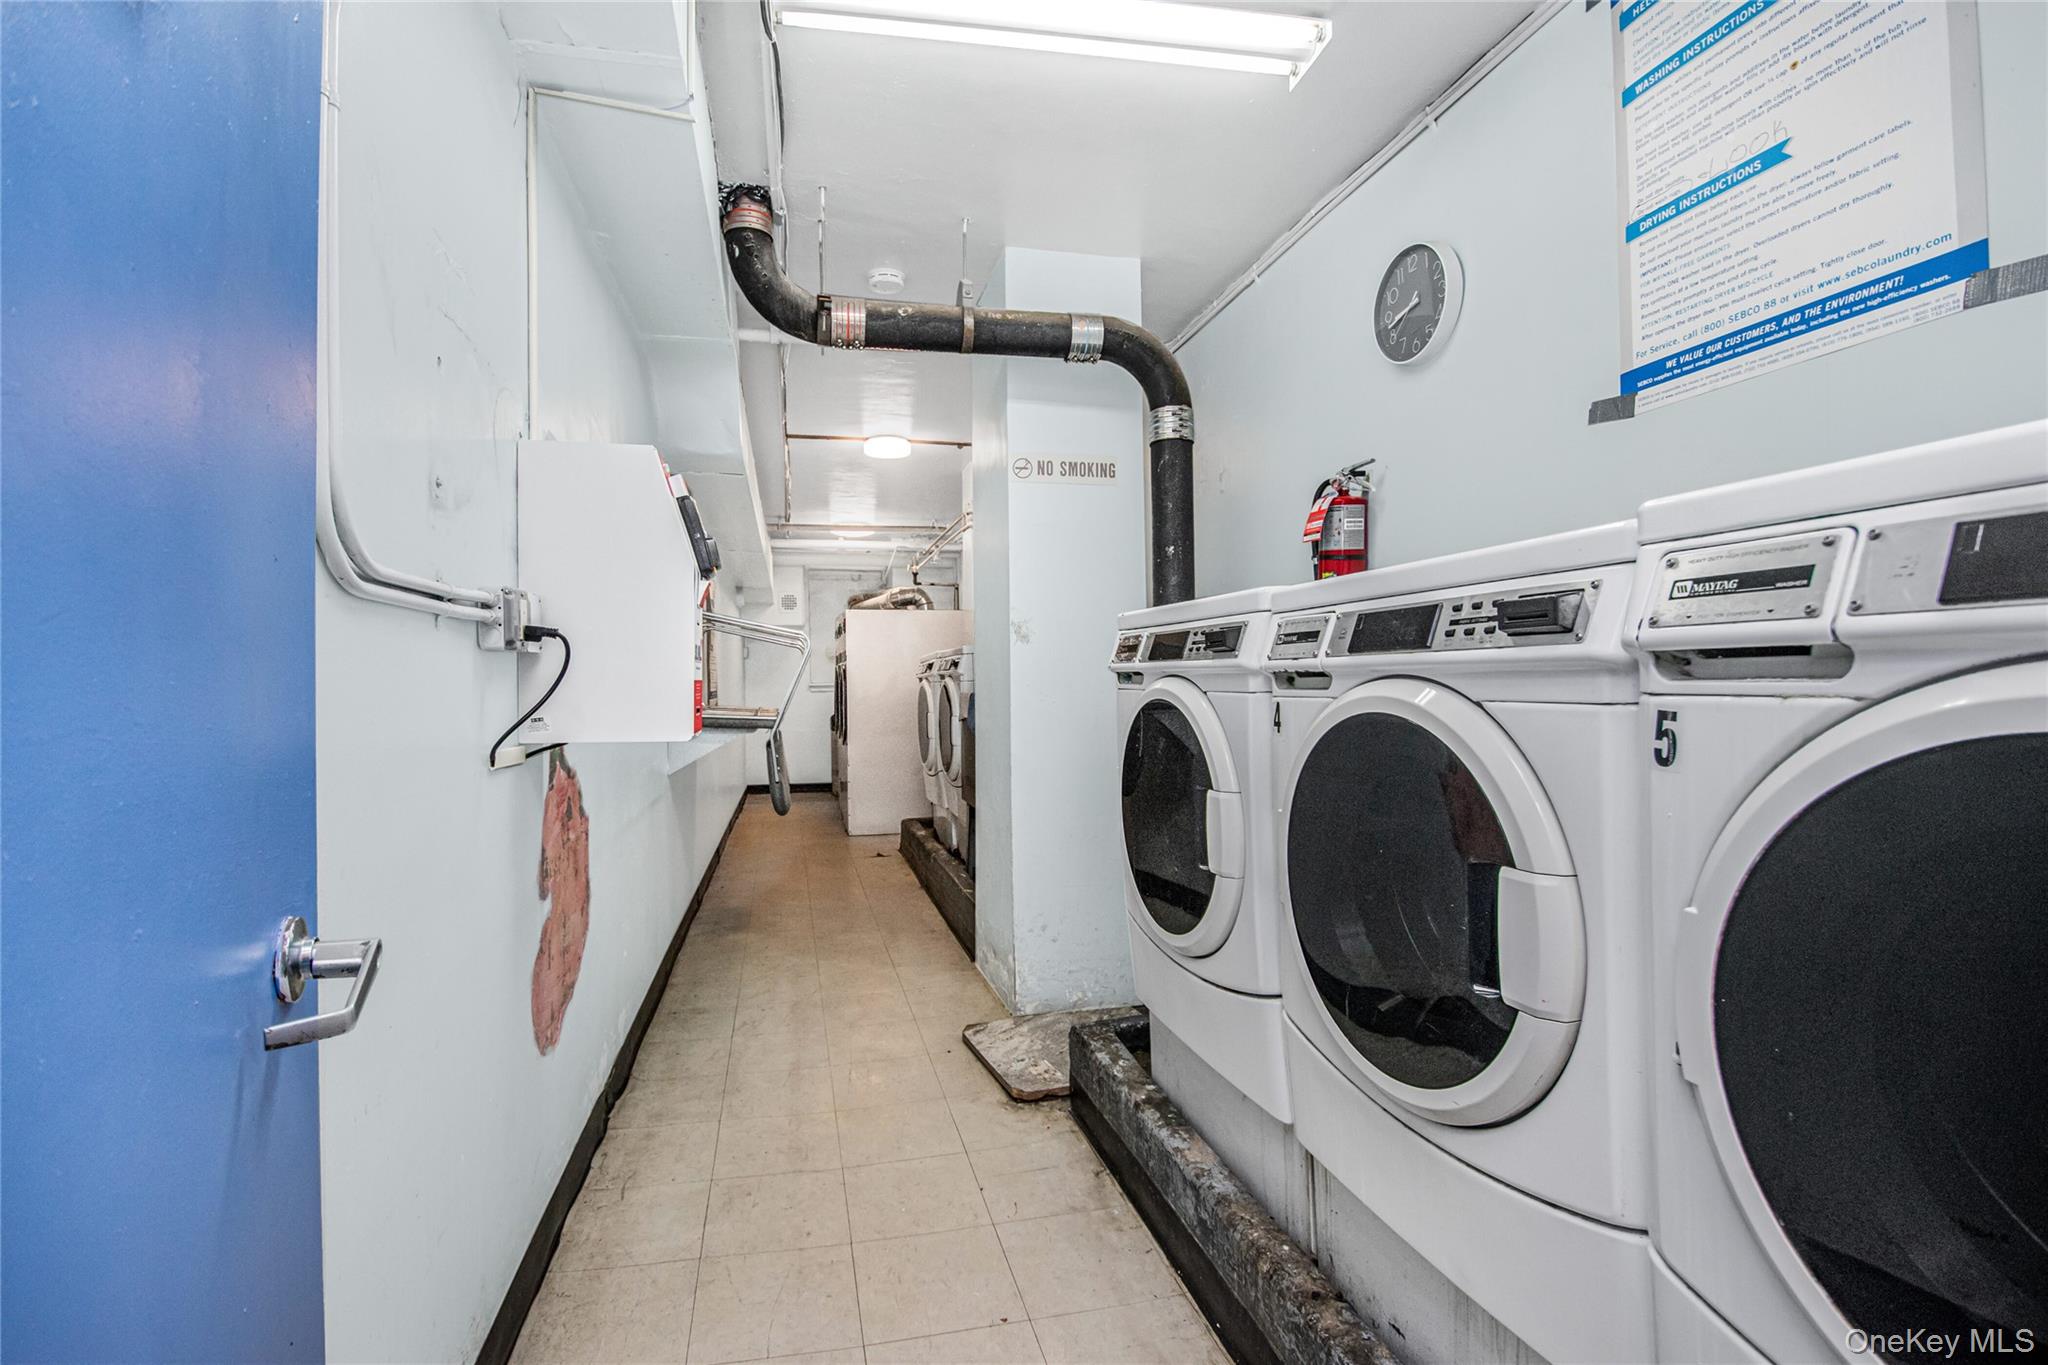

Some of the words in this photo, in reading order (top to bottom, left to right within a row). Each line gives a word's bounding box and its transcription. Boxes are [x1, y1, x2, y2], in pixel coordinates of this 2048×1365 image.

[1632, 0, 1654, 17] HEL
[1635, 58, 1680, 96] WASHING
[1683, 0, 1764, 63] INSTRUCTIONS
[1640, 207, 1676, 232] DRYING
[1680, 160, 1762, 211] INSTRUCTIONS
[1407, 254, 1418, 273] 12
[1433, 261, 1442, 280] 2
[1396, 268, 1405, 285] 11
[1386, 287, 1399, 306] 10
[1438, 280, 1447, 298] 3
[1636, 351, 1647, 359] For
[1683, 329, 1698, 341] call
[1701, 319, 1725, 336] (800)
[1728, 305, 1760, 324] SEBCO
[1763, 299, 1776, 311] 88
[1780, 296, 1788, 304] or
[1793, 284, 1814, 299] visit
[1819, 233, 1952, 290] www.sebcolaundry.com
[1666, 358, 1678, 369] WE
[1680, 349, 1703, 364] VALUE
[1706, 342, 1723, 355] OUR
[1724, 321, 1779, 348] CUSTOMERS,
[1781, 313, 1801, 327] AND
[1804, 305, 1822, 319] THE
[1825, 275, 1904, 312] ENVIRONMENT!
[1389, 328, 1397, 345] 8
[1399, 336, 1407, 354] 7
[1412, 337, 1421, 354] 6
[1037, 460, 1054, 476] NO
[1060, 461, 1116, 478] SMOKING
[1692, 579, 1739, 593] MAYTAG
[1274, 702, 1281, 733] 4
[1654, 710, 1677, 767] 5
